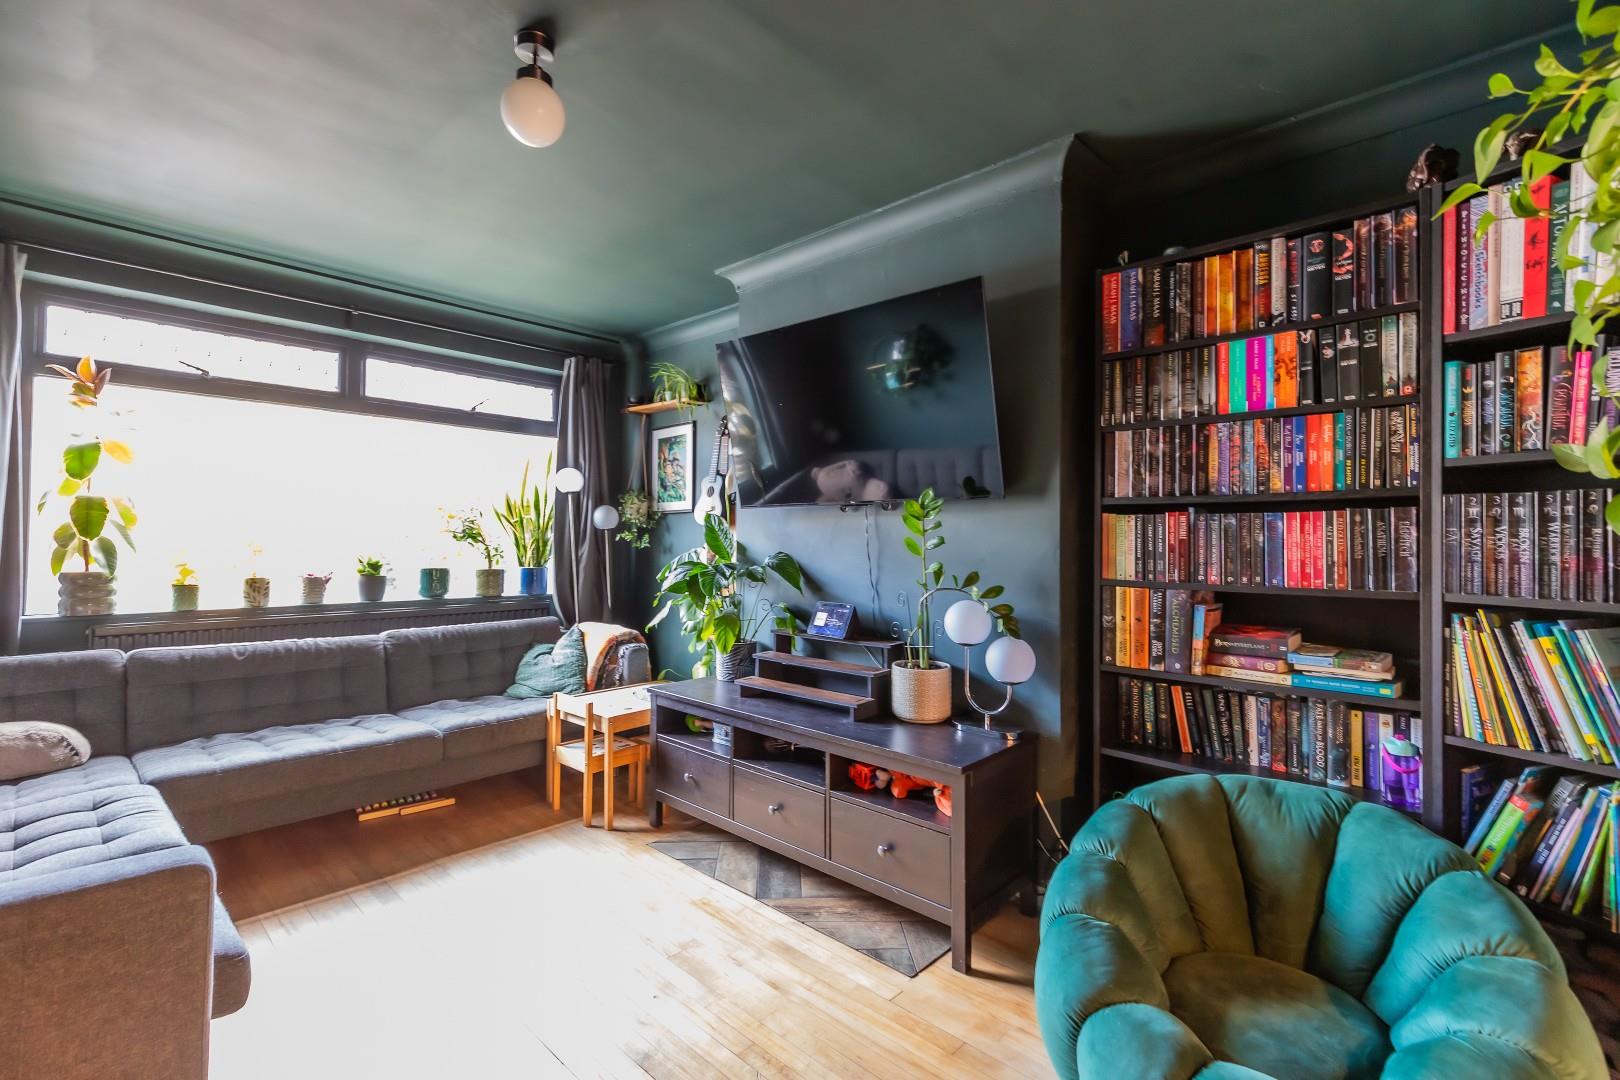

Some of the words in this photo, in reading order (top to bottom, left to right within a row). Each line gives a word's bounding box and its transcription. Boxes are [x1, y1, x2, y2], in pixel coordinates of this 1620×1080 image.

[1474, 251, 1485, 309] Sketchbooks
[1518, 528, 1529, 563] BROKEN
[1171, 598, 1181, 655] ALCHEMISED
[1315, 703, 1325, 720] FATE
[1315, 741, 1325, 768] BLOOD
